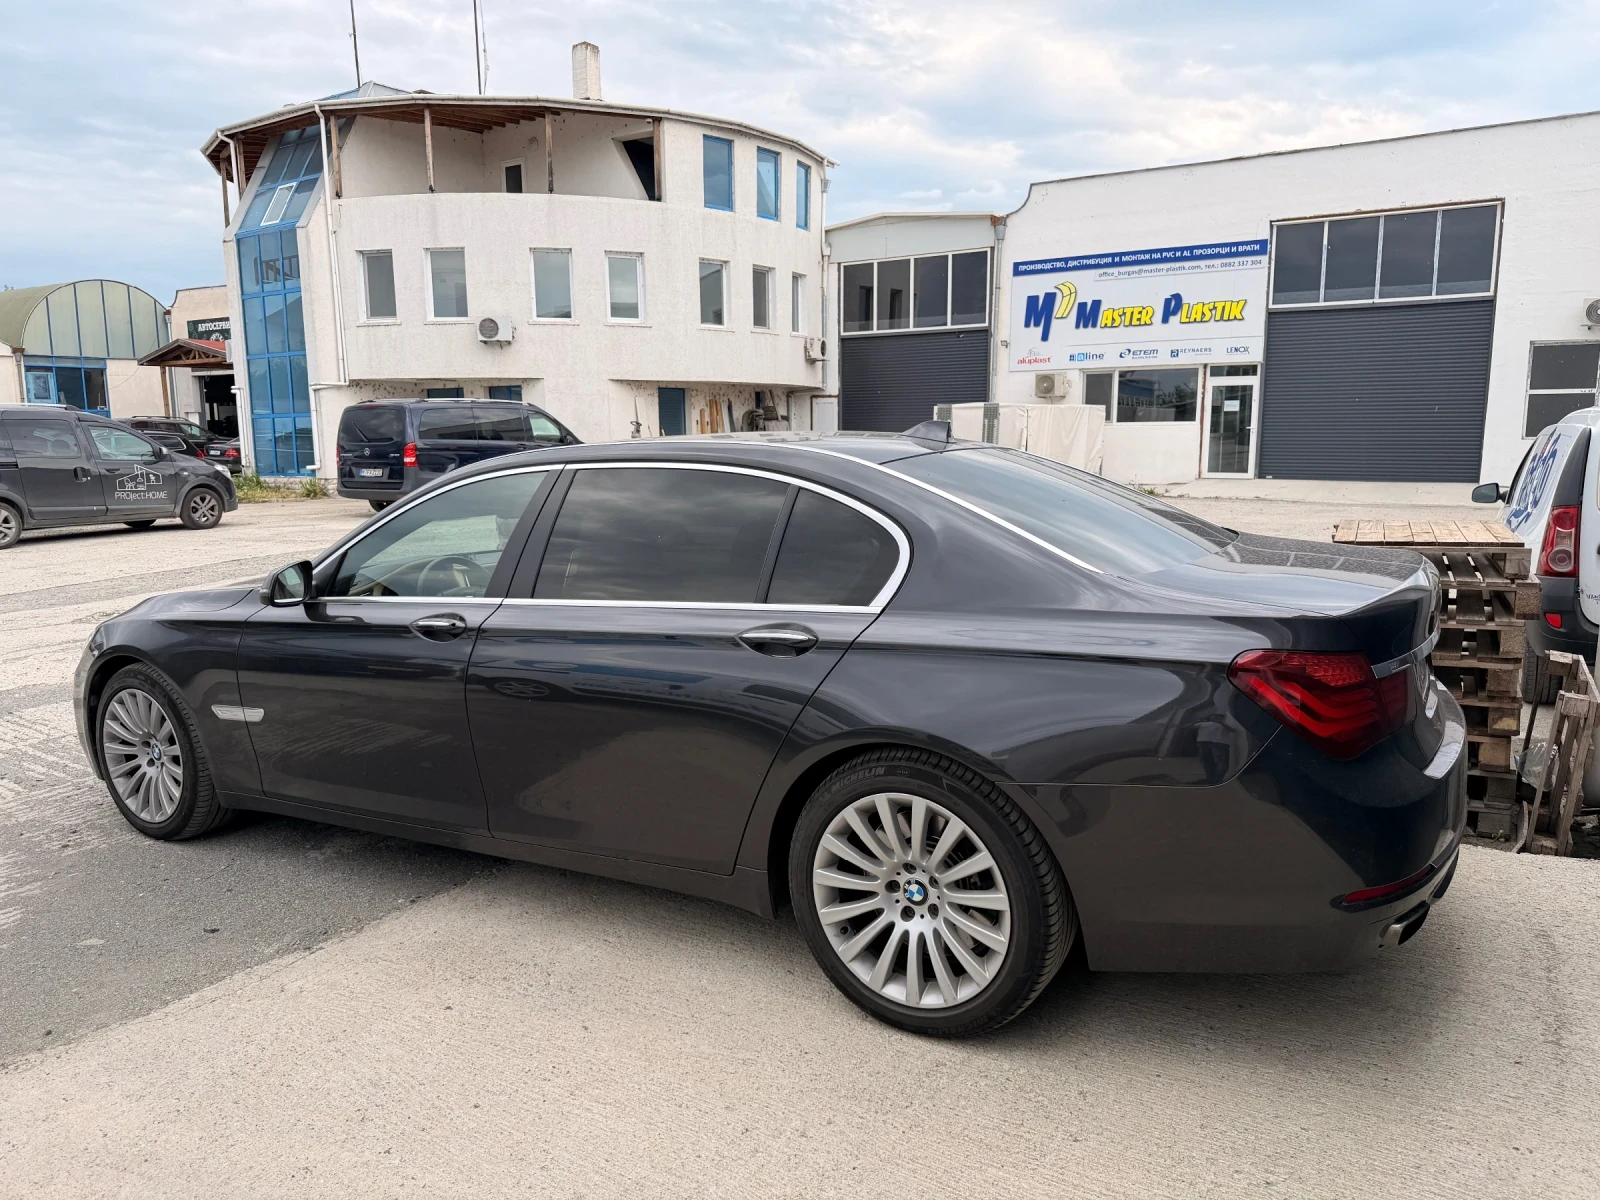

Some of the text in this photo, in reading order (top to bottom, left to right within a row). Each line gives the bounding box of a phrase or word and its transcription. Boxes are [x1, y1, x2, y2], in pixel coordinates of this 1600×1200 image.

[1018, 261, 1067, 272] ПРОИЗВОДСТВО,
[1067, 256, 1112, 267] ДИСТРИБУЦИЯ
[1121, 253, 1151, 262] МОНТАЖ
[1182, 249, 1191, 257] AL
[1193, 246, 1230, 256] ПРОЗОРЦИ
[1231, 245, 1237, 253] И
[1238, 243, 1260, 252] ВРАТИ
[1220, 261, 1236, 269] 0882
[1075, 292, 1247, 329] MASTER PLASTIK
[198, 320, 231, 332] АВТОСЕРВИ
[1132, 348, 1159, 356] ETEM
[1226, 346, 1250, 355] LENOX
[1017, 356, 1052, 365] aluplast
[831, 766, 886, 793] MICHELIN
